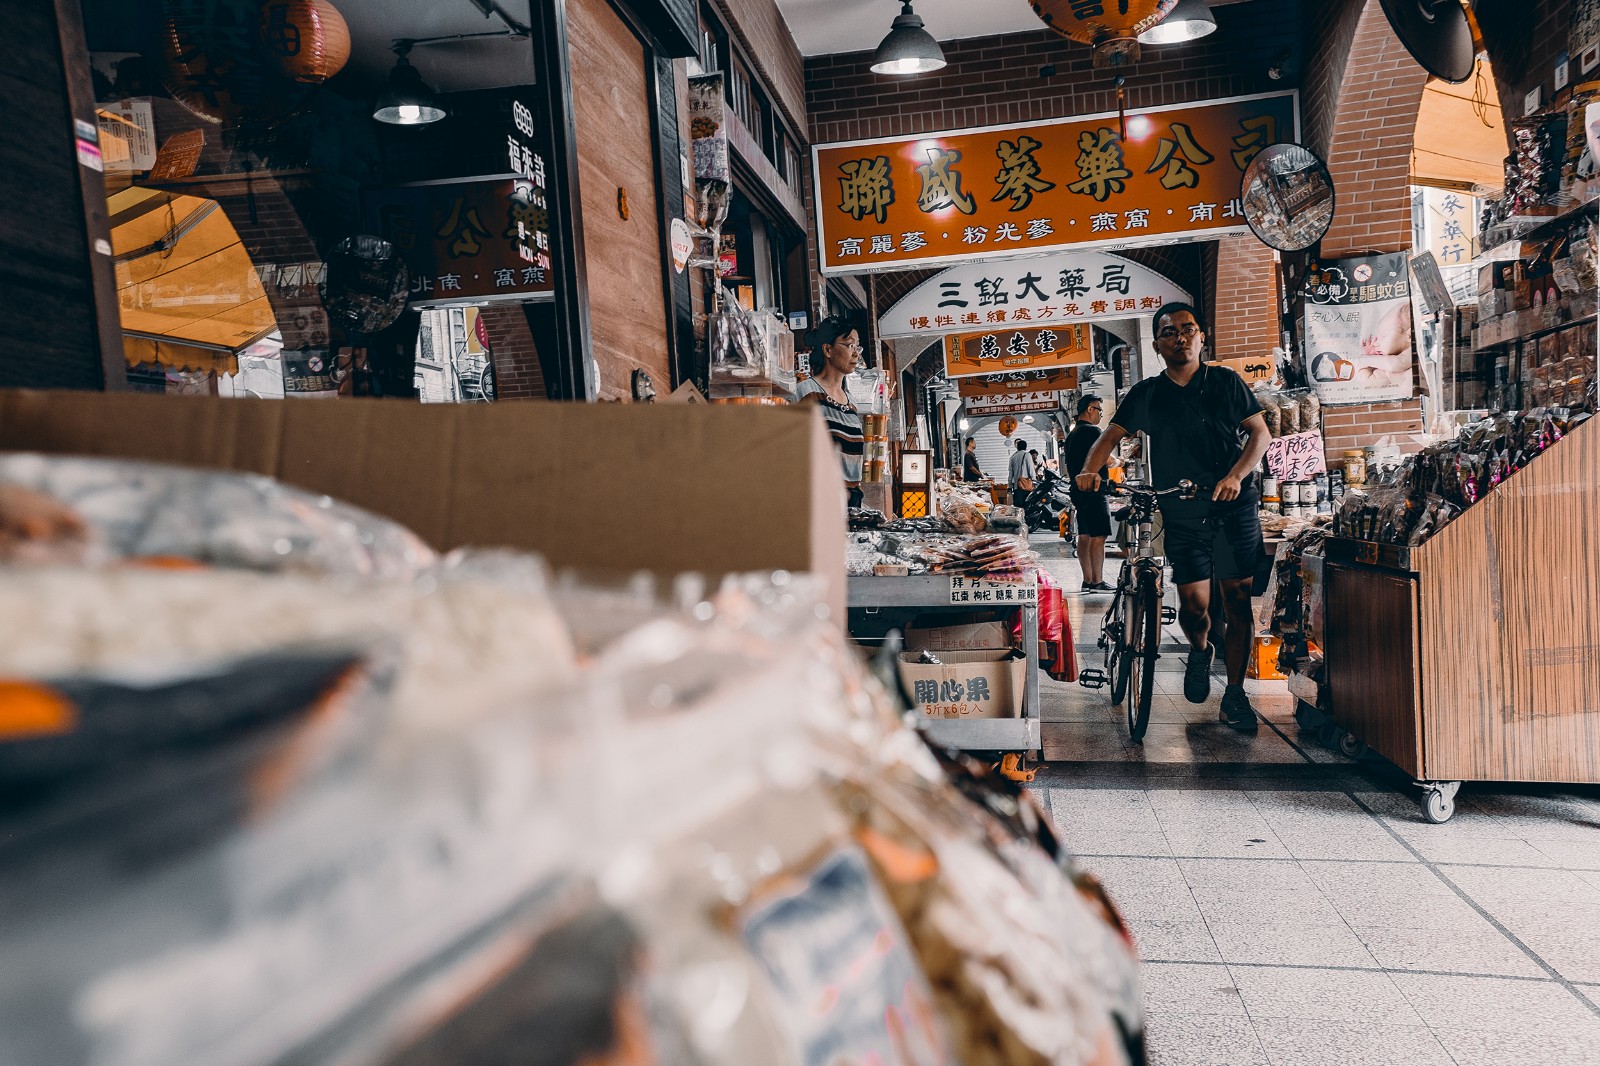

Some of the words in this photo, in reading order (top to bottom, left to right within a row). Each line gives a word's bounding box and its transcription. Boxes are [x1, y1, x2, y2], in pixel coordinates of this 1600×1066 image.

[508, 135, 546, 189] 福來許
[937, 264, 1131, 308] 三銘大藥局
[1317, 284, 1341, 296] 必備
[1359, 280, 1408, 302] 驅蚊包
[910, 296, 1162, 330] 慢性連續處方免費調劑
[1310, 311, 1360, 323] 安心入眠
[979, 330, 1057, 359] 萬安堂
[914, 677, 990, 704] 開心果
